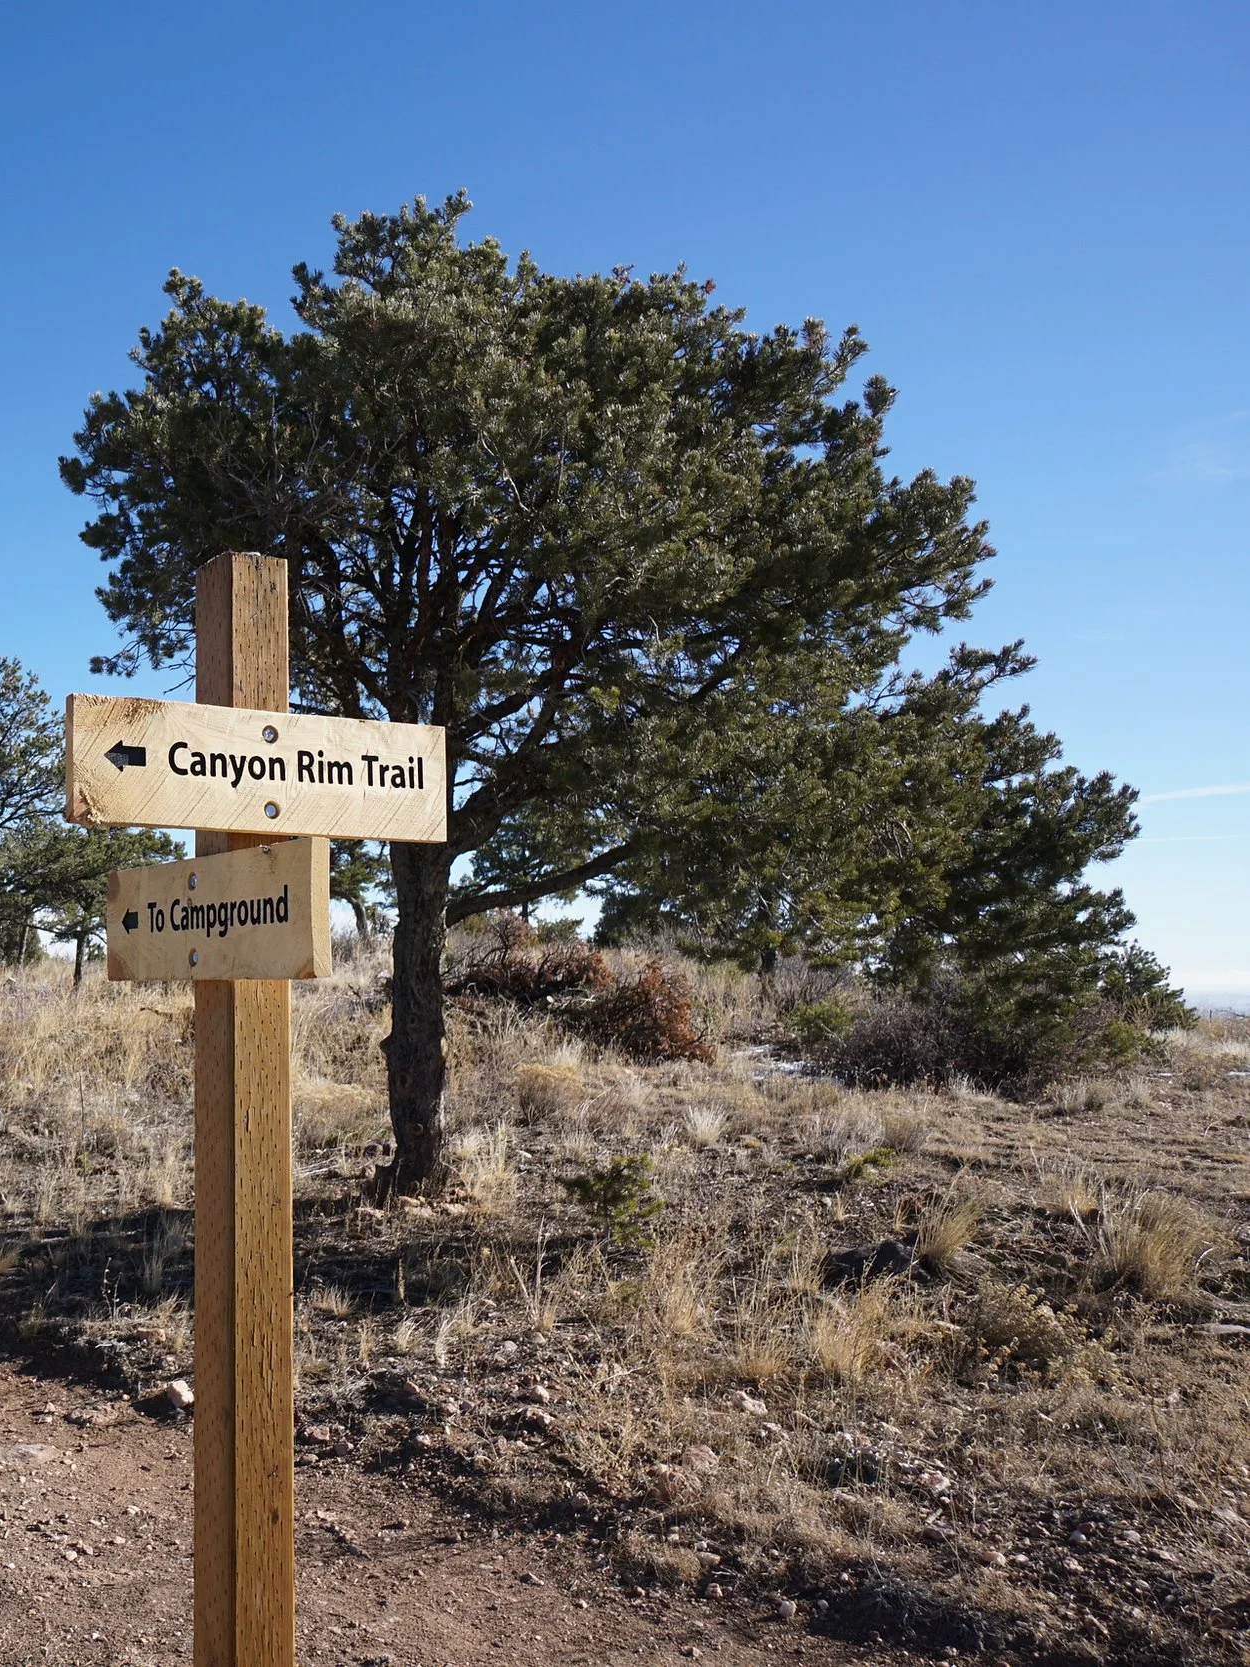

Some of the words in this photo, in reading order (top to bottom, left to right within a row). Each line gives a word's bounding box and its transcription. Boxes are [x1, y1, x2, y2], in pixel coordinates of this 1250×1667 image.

[168, 741, 286, 788] Canyon
[297, 750, 353, 786] Rim
[361, 755, 424, 789] Trail
[147, 901, 165, 933] To
[169, 884, 289, 938] Campground
